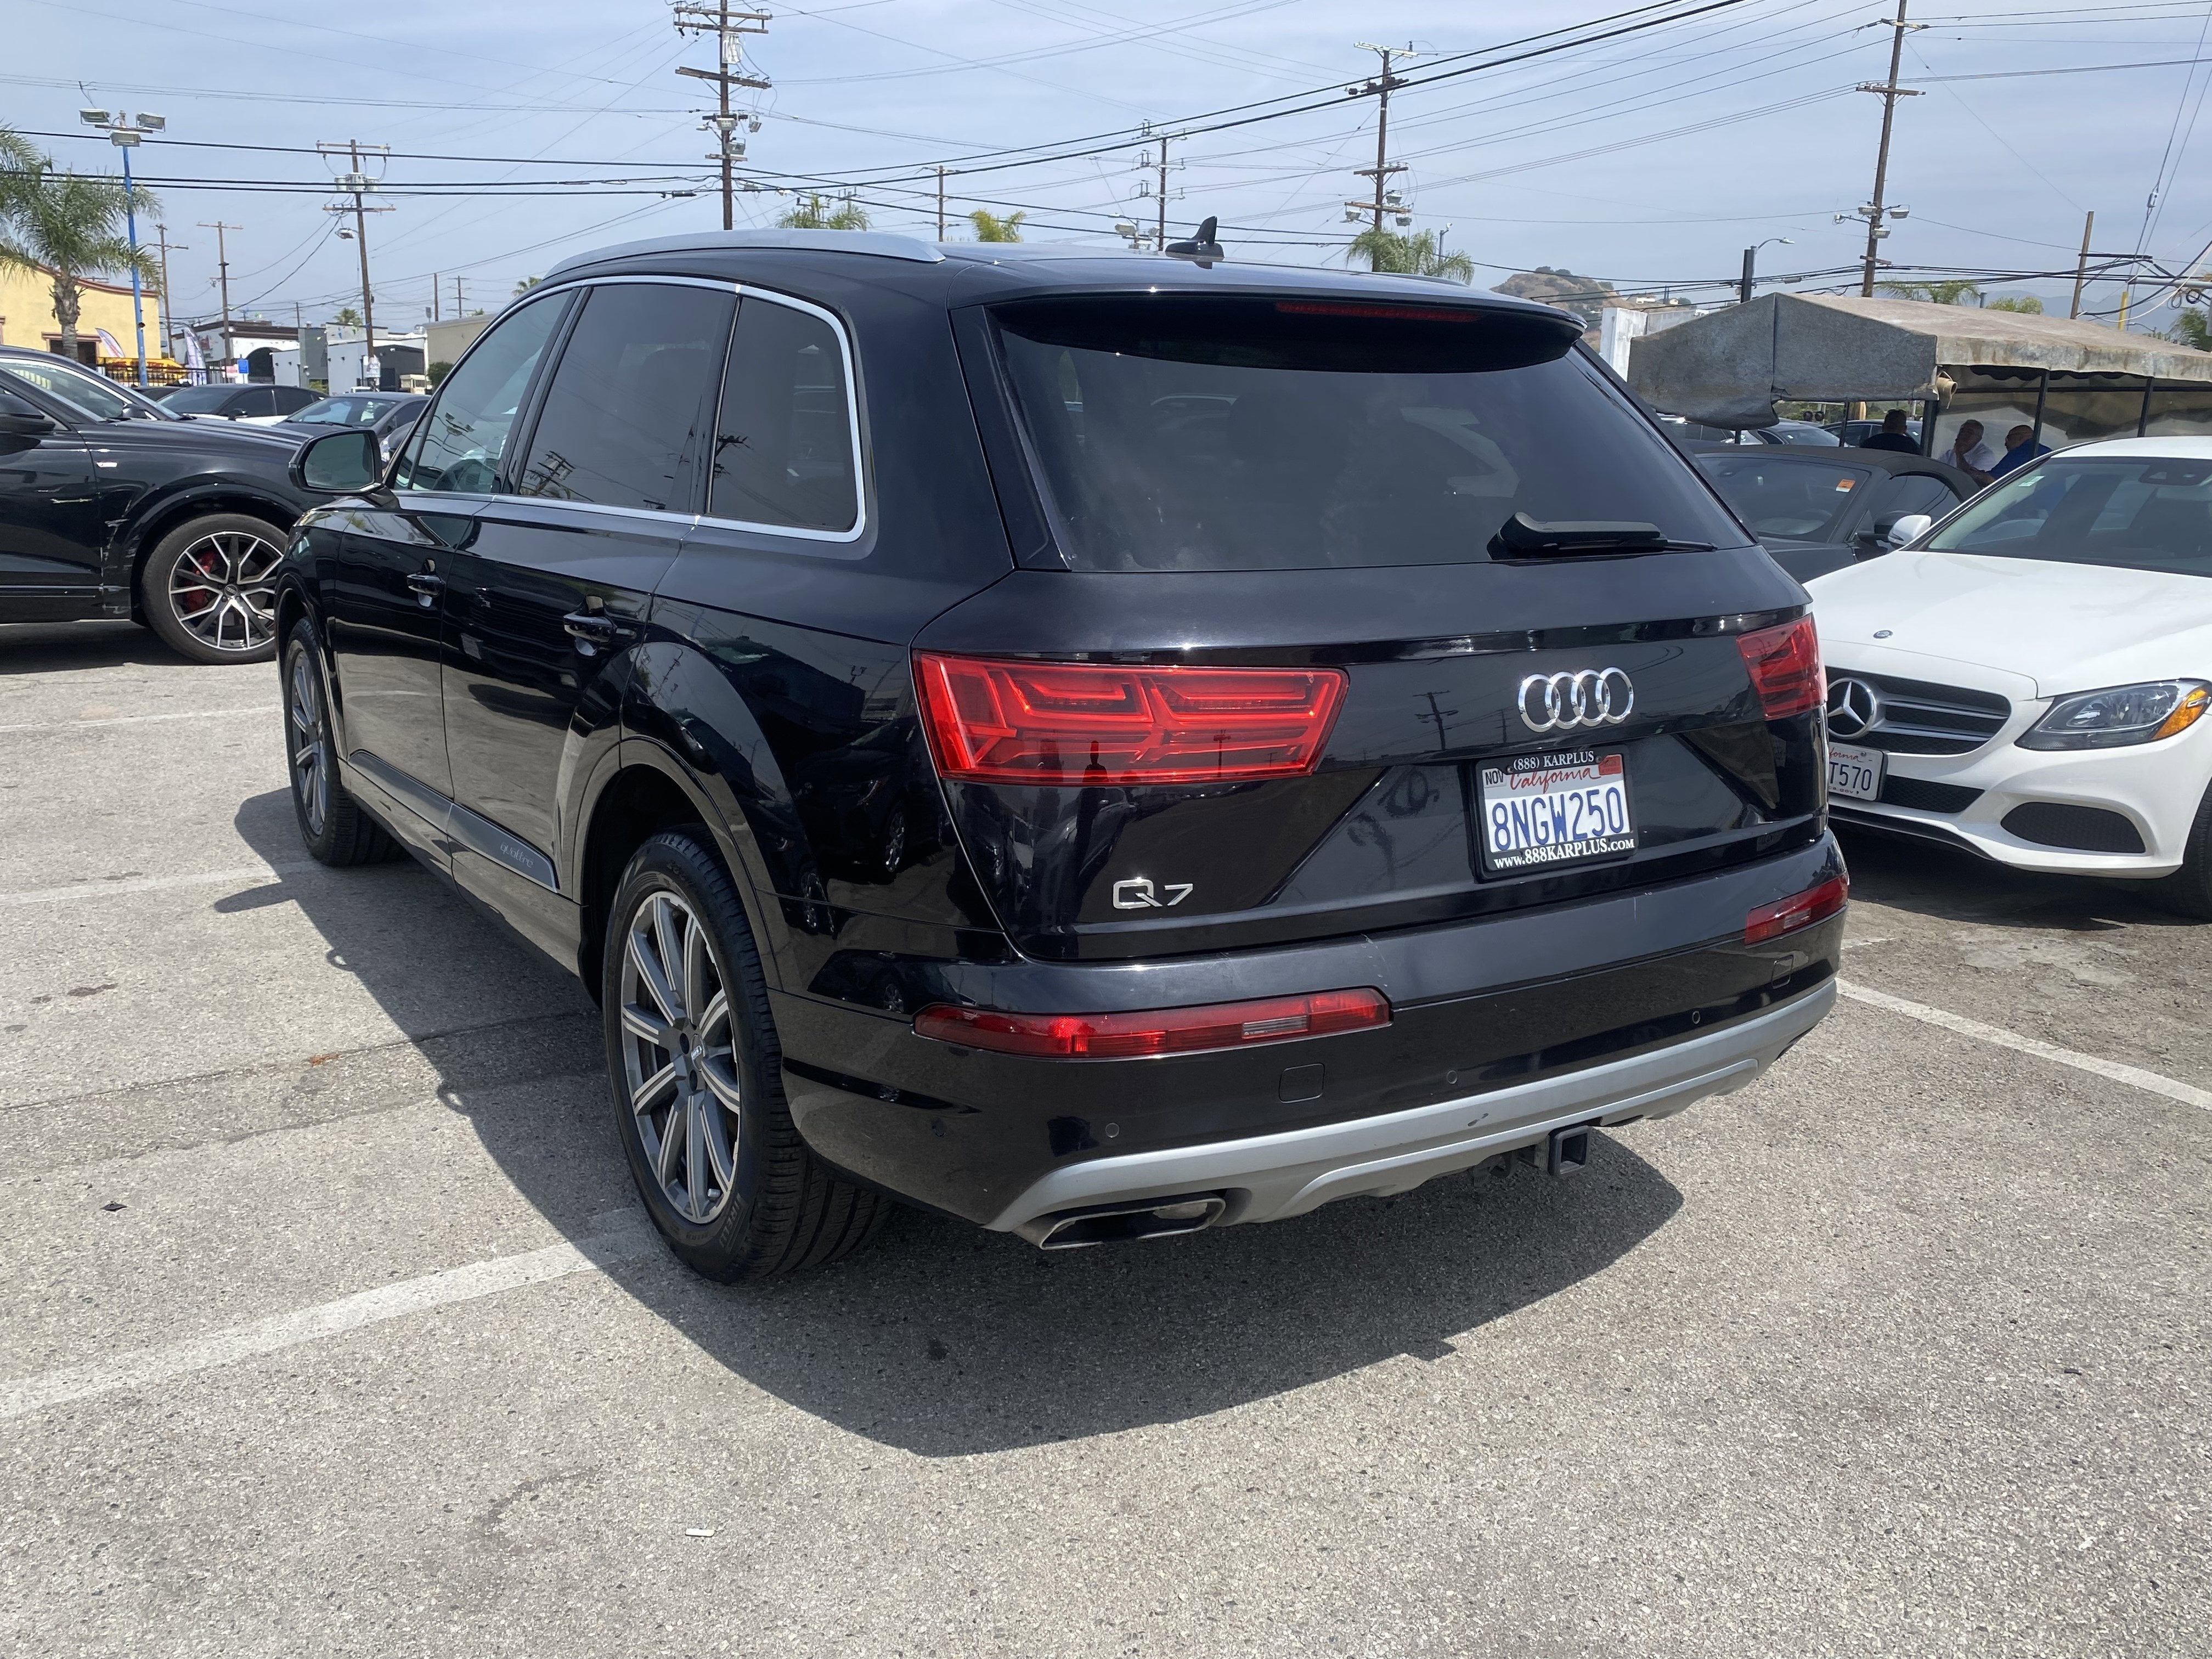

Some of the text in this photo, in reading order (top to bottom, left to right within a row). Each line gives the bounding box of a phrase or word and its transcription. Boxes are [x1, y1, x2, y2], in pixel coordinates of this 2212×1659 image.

[1513, 757, 1539, 771] (888)
[1543, 751, 1594, 768] KARPLUS
[1829, 747, 1864, 763] fornia
[1485, 770, 1504, 785] NOV
[1510, 766, 1601, 794] California
[1829, 761, 1872, 791] T570
[1492, 787, 1624, 851] 8NGW250
[1113, 878, 1193, 910] Q7
